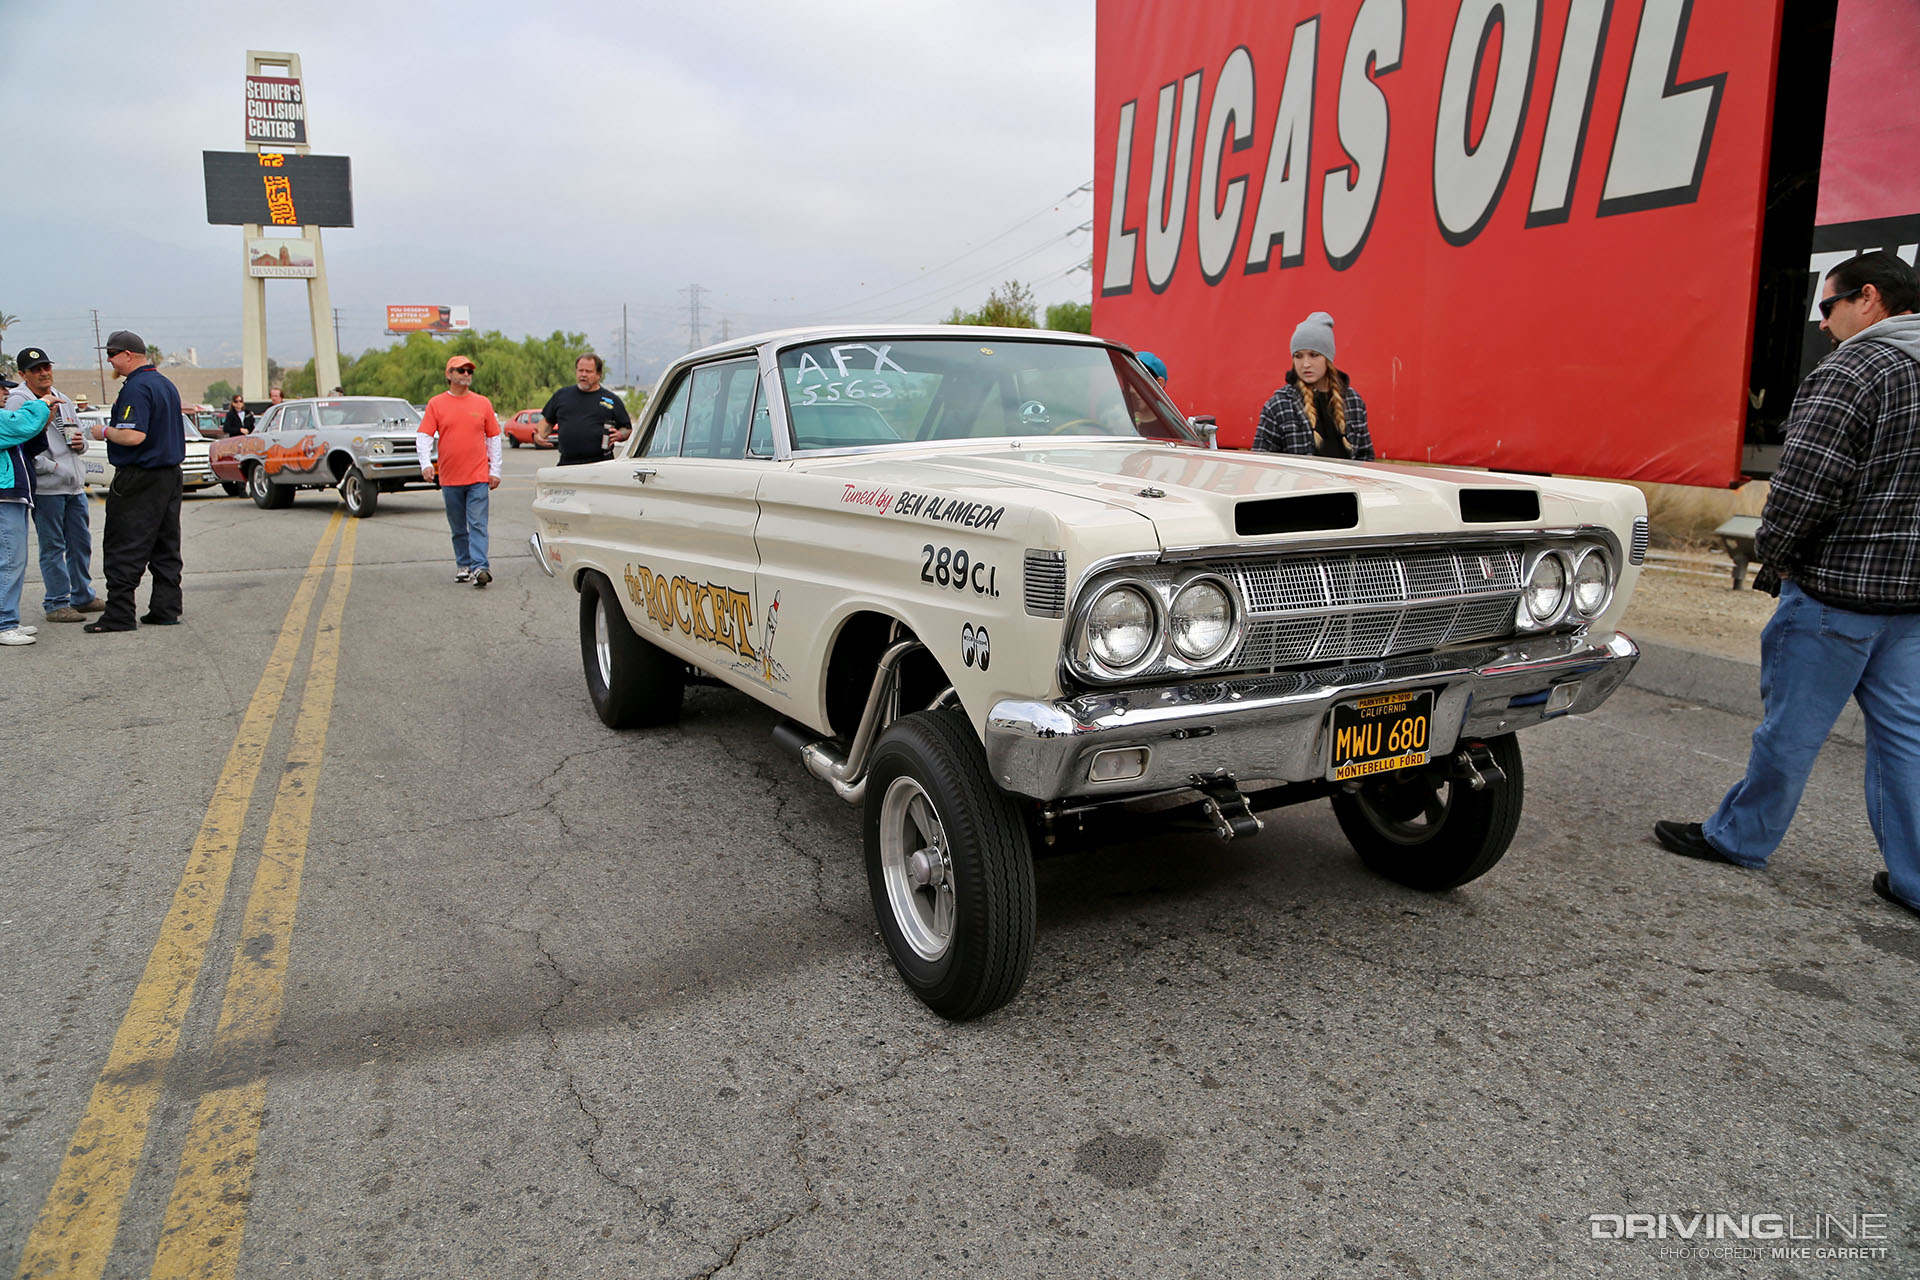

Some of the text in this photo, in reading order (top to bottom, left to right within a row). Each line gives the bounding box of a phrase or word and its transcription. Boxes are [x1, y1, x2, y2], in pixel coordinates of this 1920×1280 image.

[246, 80, 301, 101] SEIDNER'S
[247, 99, 304, 120] COLLISION
[248, 118, 296, 138] CENTERS
[1101, 0, 1728, 297] LUCAS OIL
[252, 267, 315, 277] IRWINDALE
[796, 344, 908, 384] AFX
[802, 379, 892, 405] 5563
[841, 484, 1005, 531] Tuned by BEN ALAMEDA
[921, 544, 970, 590] 289
[624, 563, 760, 662] the ROCKET
[1359, 695, 1389, 708] PARKVIEW
[1361, 703, 1406, 718] CALIFORNIA
[1336, 715, 1426, 761] MWU 680
[1337, 753, 1423, 779] MONTEBELLO FORD
